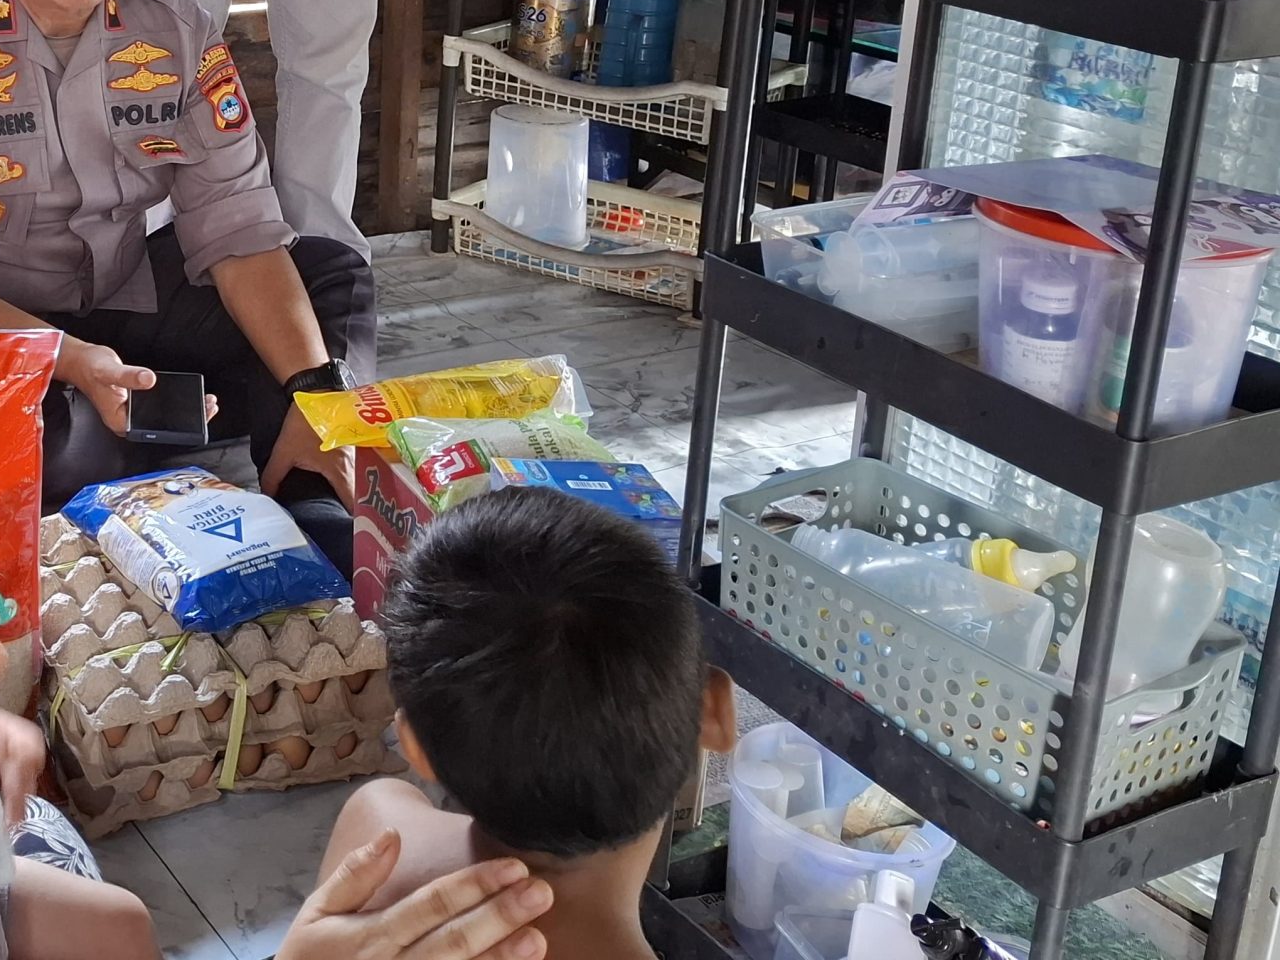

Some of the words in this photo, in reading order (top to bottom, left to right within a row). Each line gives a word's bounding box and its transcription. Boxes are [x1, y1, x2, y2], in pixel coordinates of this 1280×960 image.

[111, 102, 183, 127] POLRI
[186, 504, 246, 532] SEGITIGA
[193, 504, 225, 521] BIRU
[226, 541, 270, 560] bogasari
